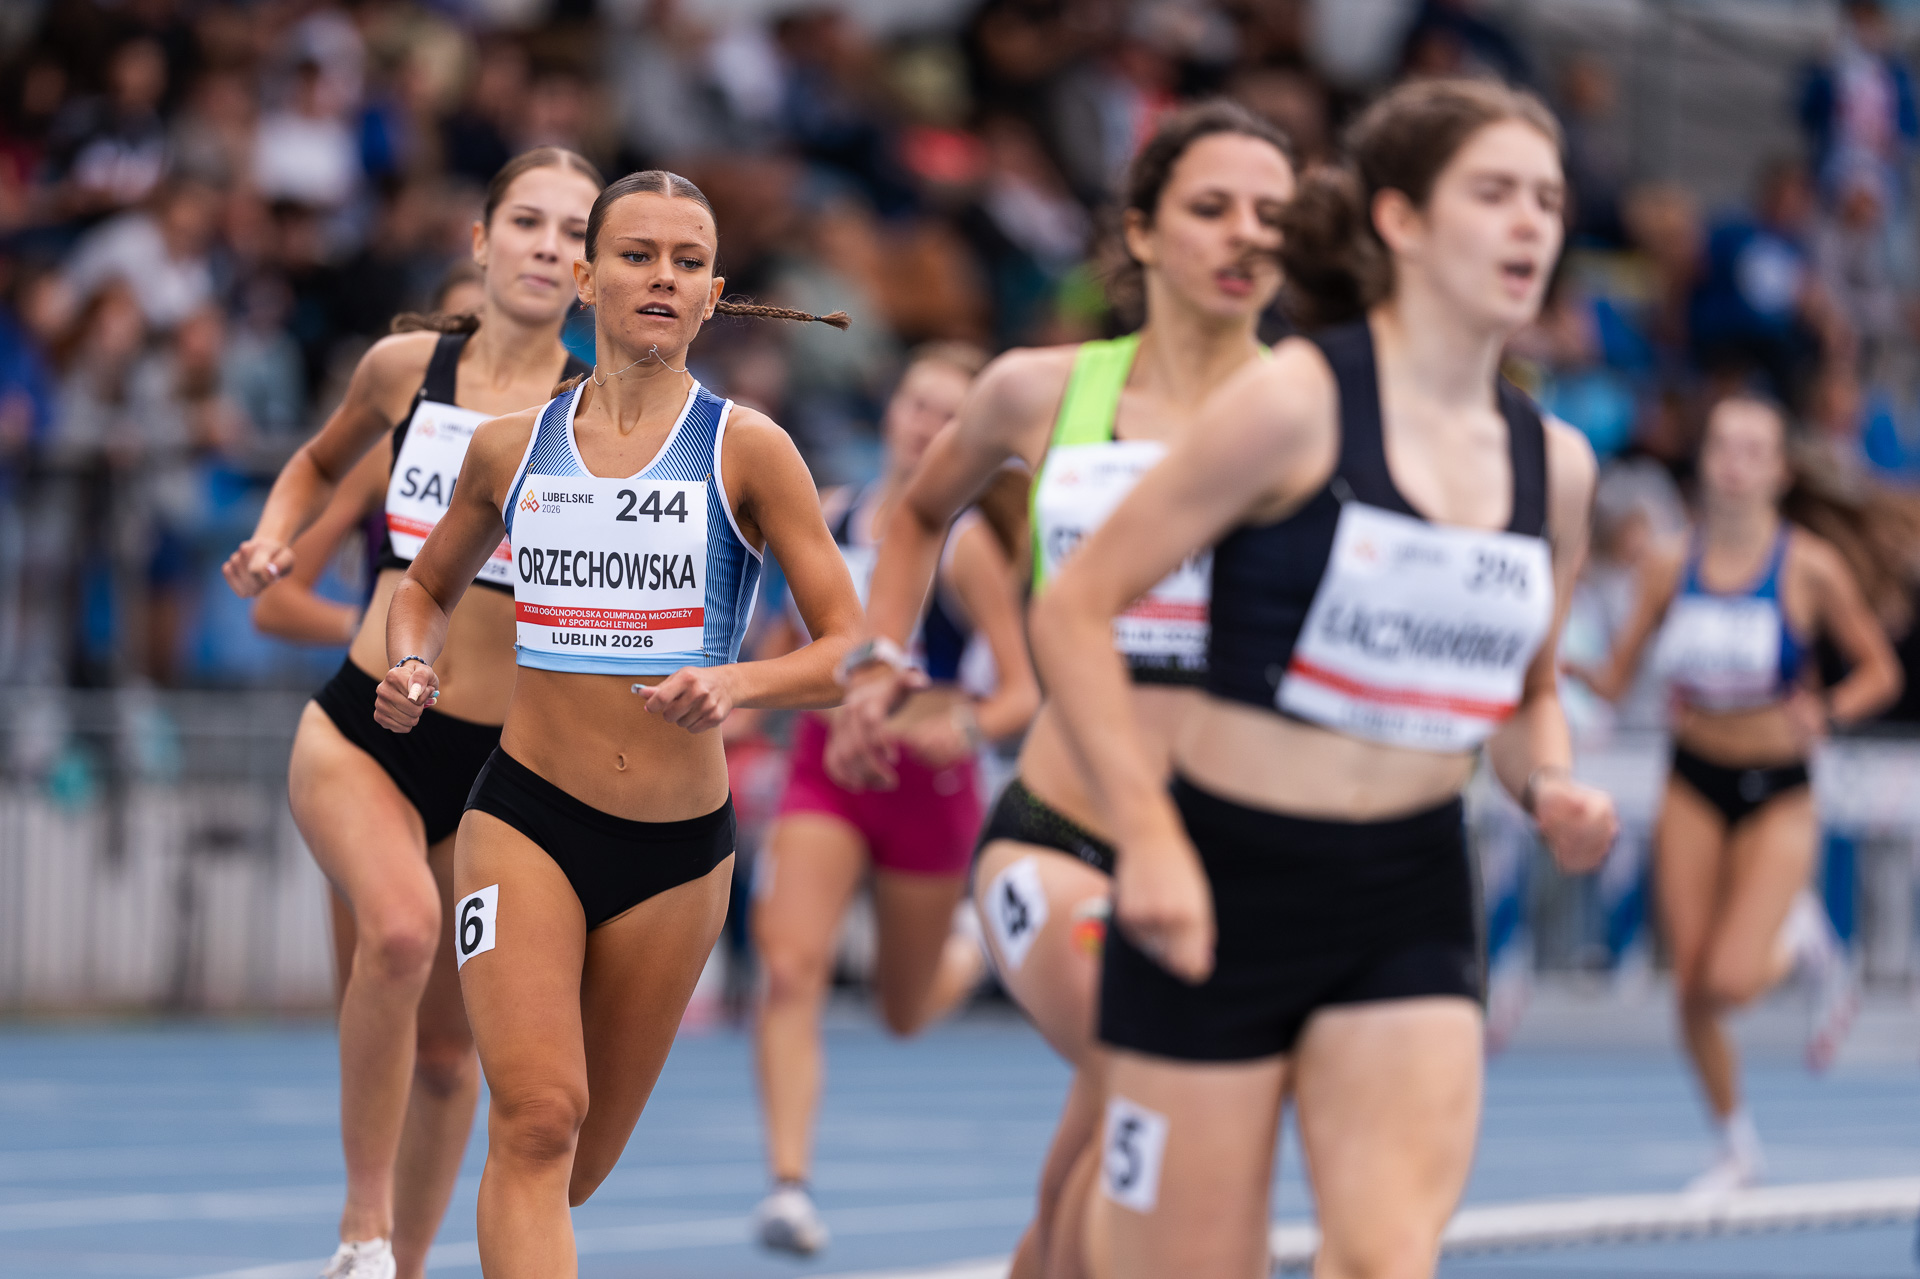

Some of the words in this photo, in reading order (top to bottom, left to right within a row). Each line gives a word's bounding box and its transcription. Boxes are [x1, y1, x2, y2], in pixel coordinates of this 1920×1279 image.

[542, 491, 594, 504] LUBELSKIE
[542, 504, 561, 514] 2026
[615, 489, 689, 523] 244
[518, 546, 696, 591] ORZECHOWSKA
[523, 604, 539, 614] XXXII
[539, 606, 601, 618] OGÓLNOPOLSKA
[603, 610, 647, 620] OLIMPIADA
[648, 608, 693, 620] MŁODZIEŻY
[558, 618, 567, 626] W
[568, 618, 612, 628] SPORTACH
[613, 620, 647, 629] LETNICH
[551, 632, 607, 647] LUBLIN
[611, 635, 654, 648] 2026
[460, 897, 485, 956] 6
[1111, 1114, 1145, 1193] 5
